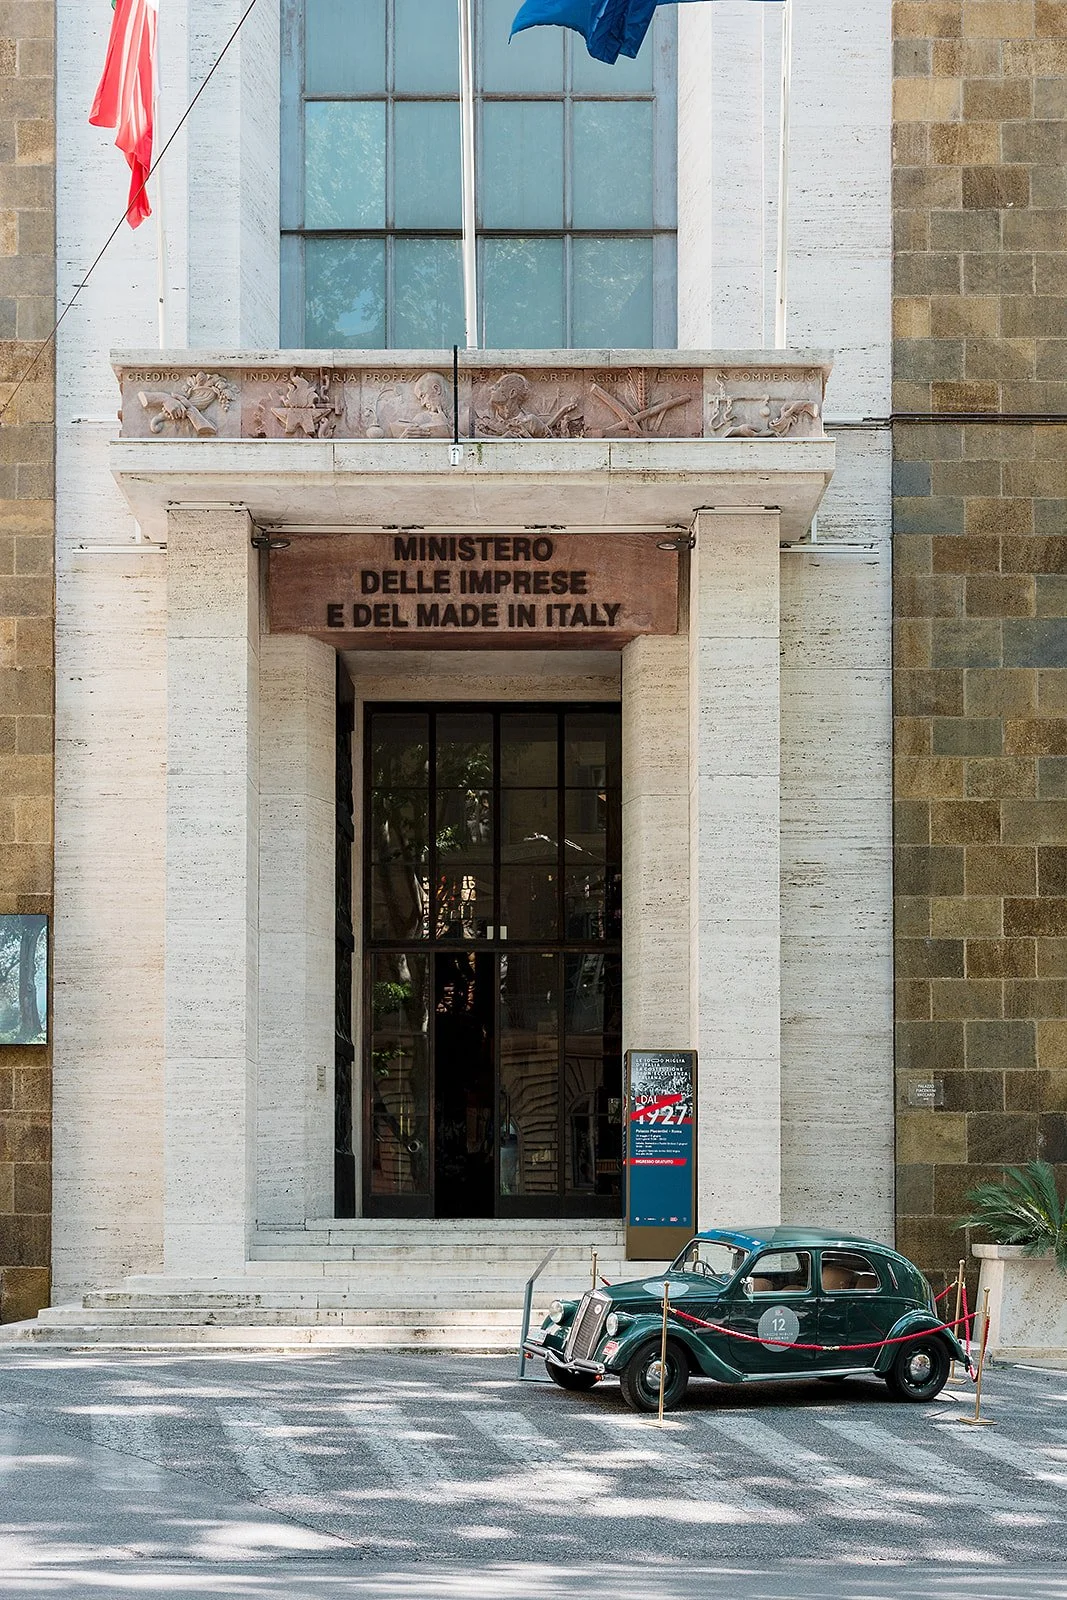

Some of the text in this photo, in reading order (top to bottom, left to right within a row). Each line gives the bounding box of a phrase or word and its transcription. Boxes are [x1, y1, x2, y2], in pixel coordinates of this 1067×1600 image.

[127, 372, 181, 383] CREDITO
[538, 373, 576, 383] ARTI
[588, 373, 700, 383] AGRICLTVRA
[733, 372, 817, 383] COMMERCIO
[394, 537, 554, 562] MINISTERO
[360, 570, 588, 595] DELLE IMPRESE
[326, 603, 622, 628] E DEL MADE IN ITALY
[640, 1094, 659, 1104] DAL
[636, 1104, 688, 1125] 1927
[771, 1318, 786, 1332] 12
